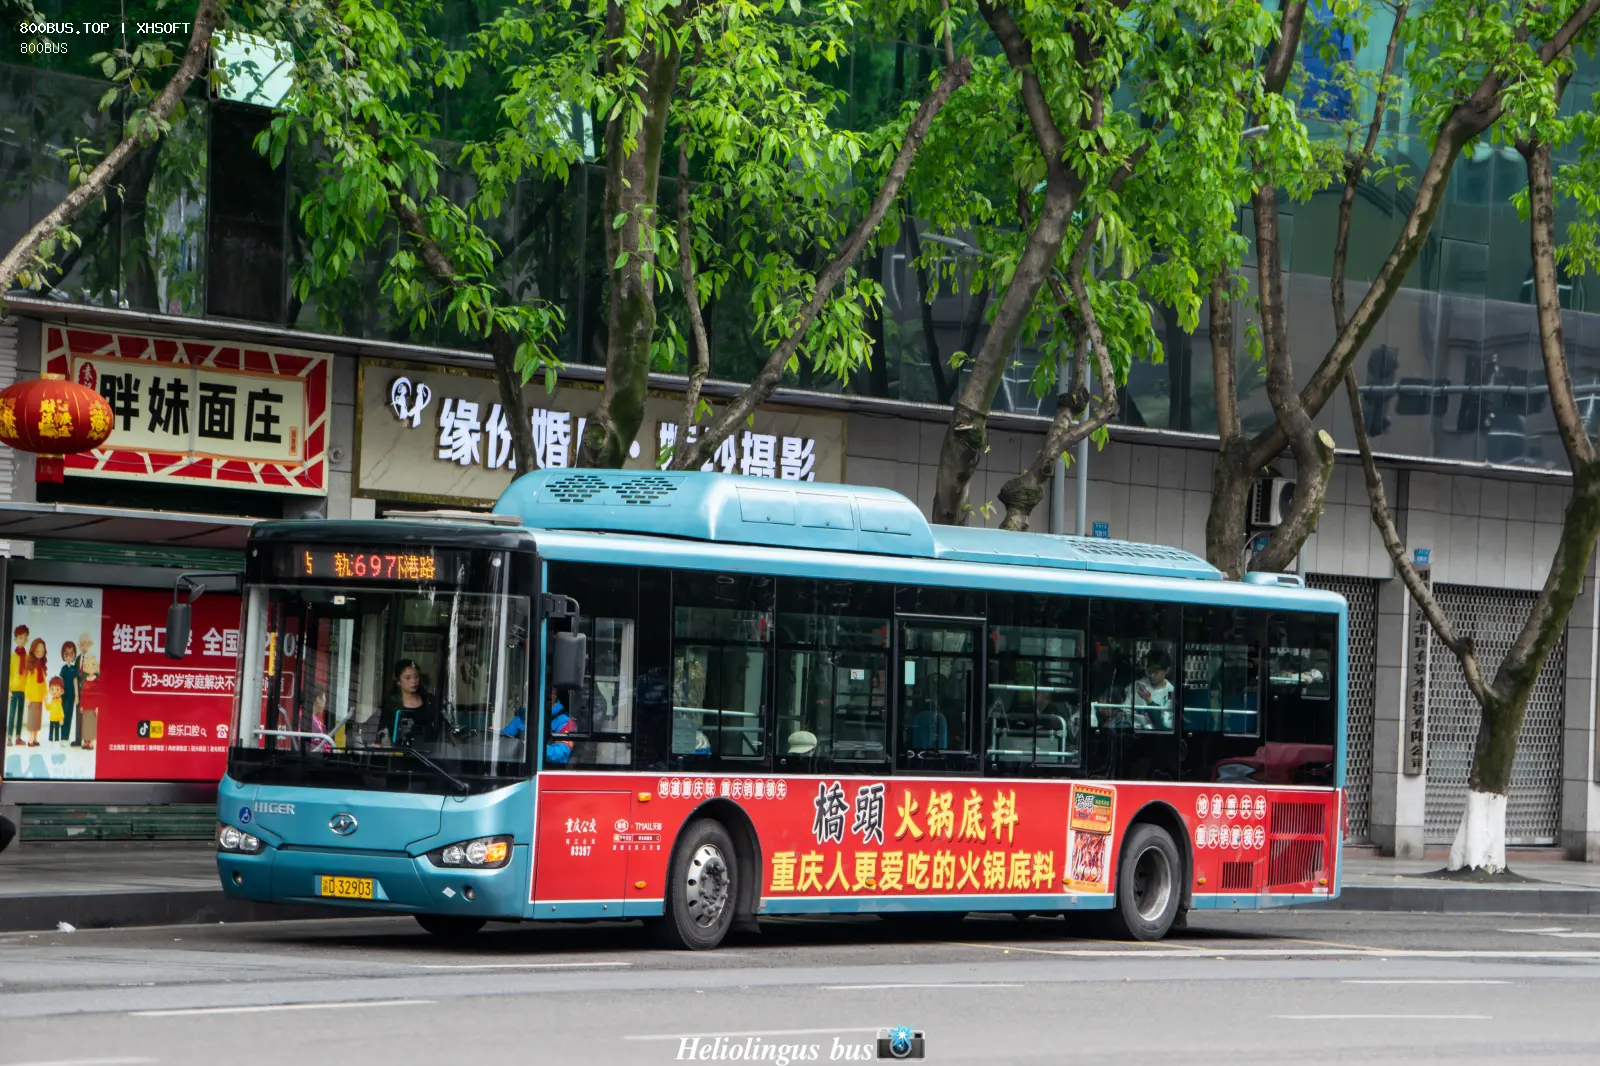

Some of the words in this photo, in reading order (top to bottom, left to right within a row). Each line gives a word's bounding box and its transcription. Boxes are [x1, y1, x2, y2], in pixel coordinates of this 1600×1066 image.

[100, 373, 284, 444] 胖妹面庄
[355, 554, 397, 578] 697
[112, 624, 193, 655] 维乐口
[658, 778, 716, 798] 地道重庆味
[254, 802, 295, 815] HIGER
[894, 788, 1019, 844] 火锅底料
[564, 818, 597, 833] 重庆公交
[770, 851, 1056, 892] 重庆人更爱吃的火锅底料
